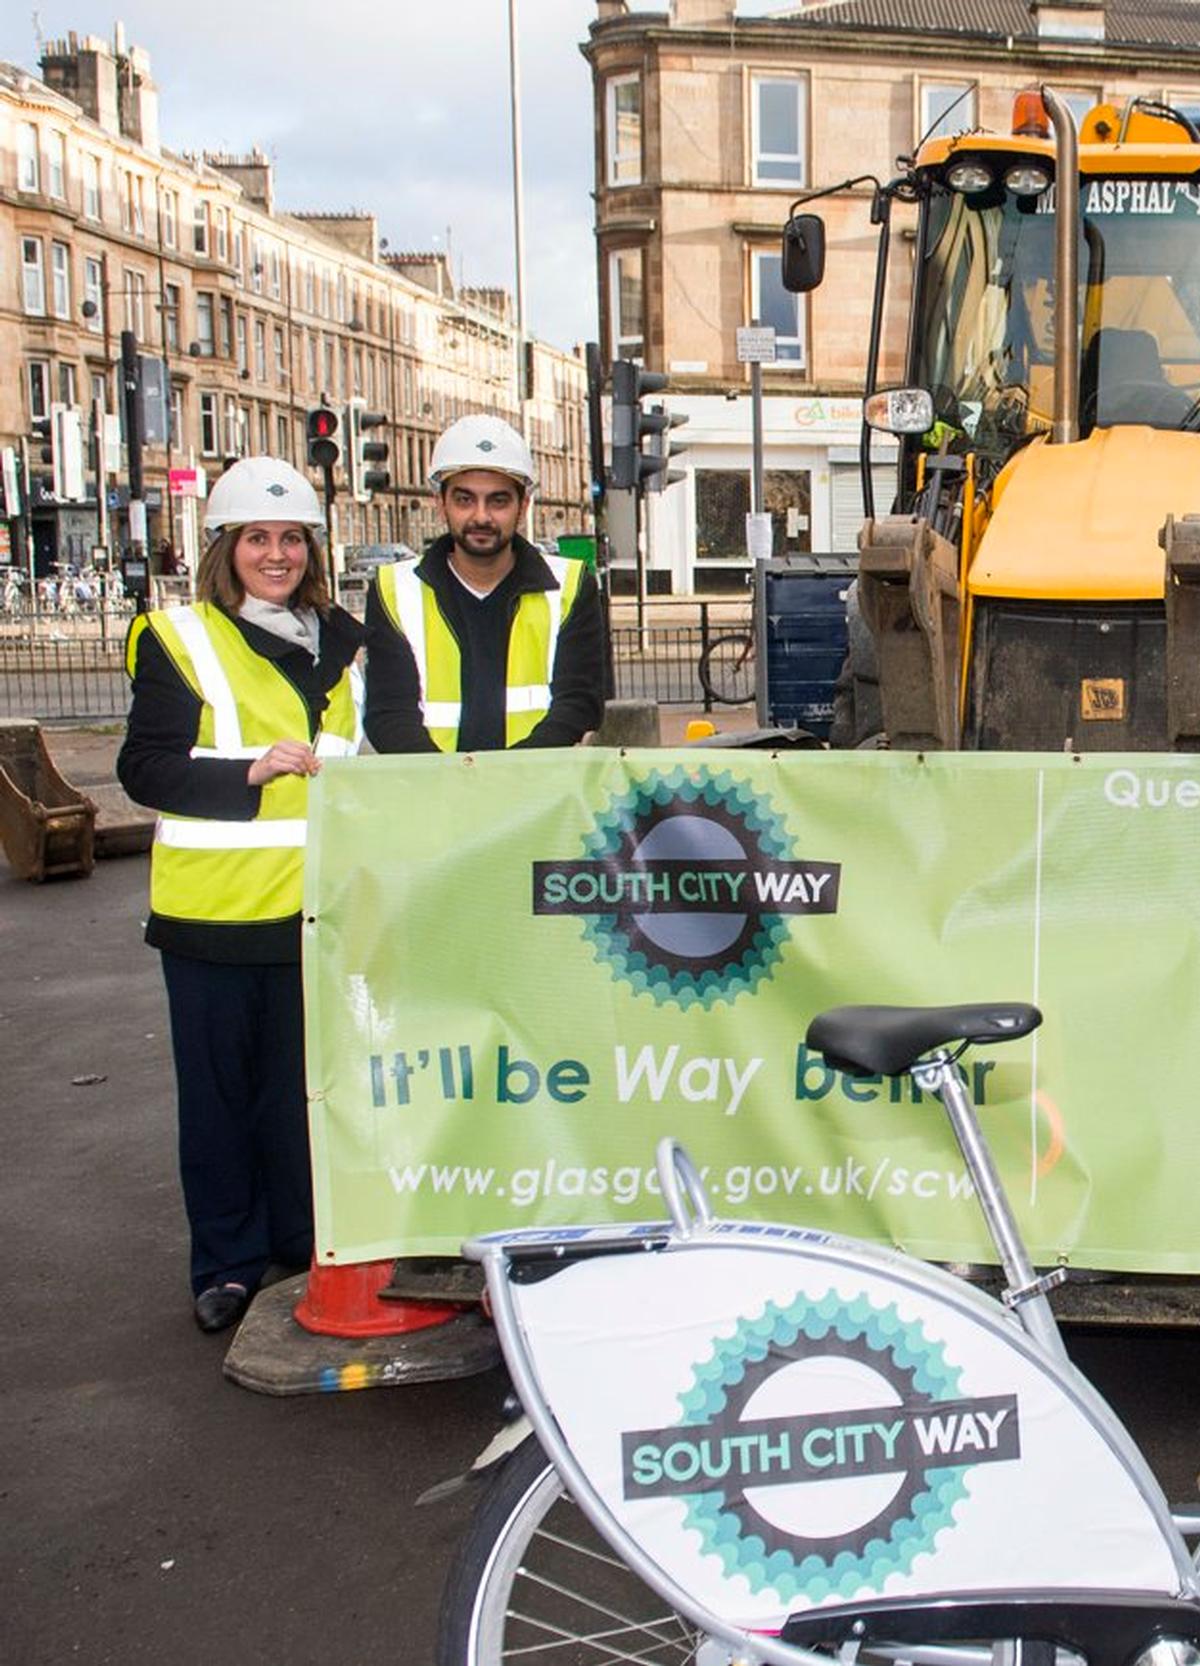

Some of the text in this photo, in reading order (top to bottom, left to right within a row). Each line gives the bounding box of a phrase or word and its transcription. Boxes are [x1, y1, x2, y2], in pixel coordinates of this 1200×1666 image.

[543, 871, 832, 904] SOUTH CITY WAY
[496, 1045, 591, 1104] be
[614, 1044, 765, 1115] Way
[632, 1409, 1009, 1485] SOUTH CITY WAY
